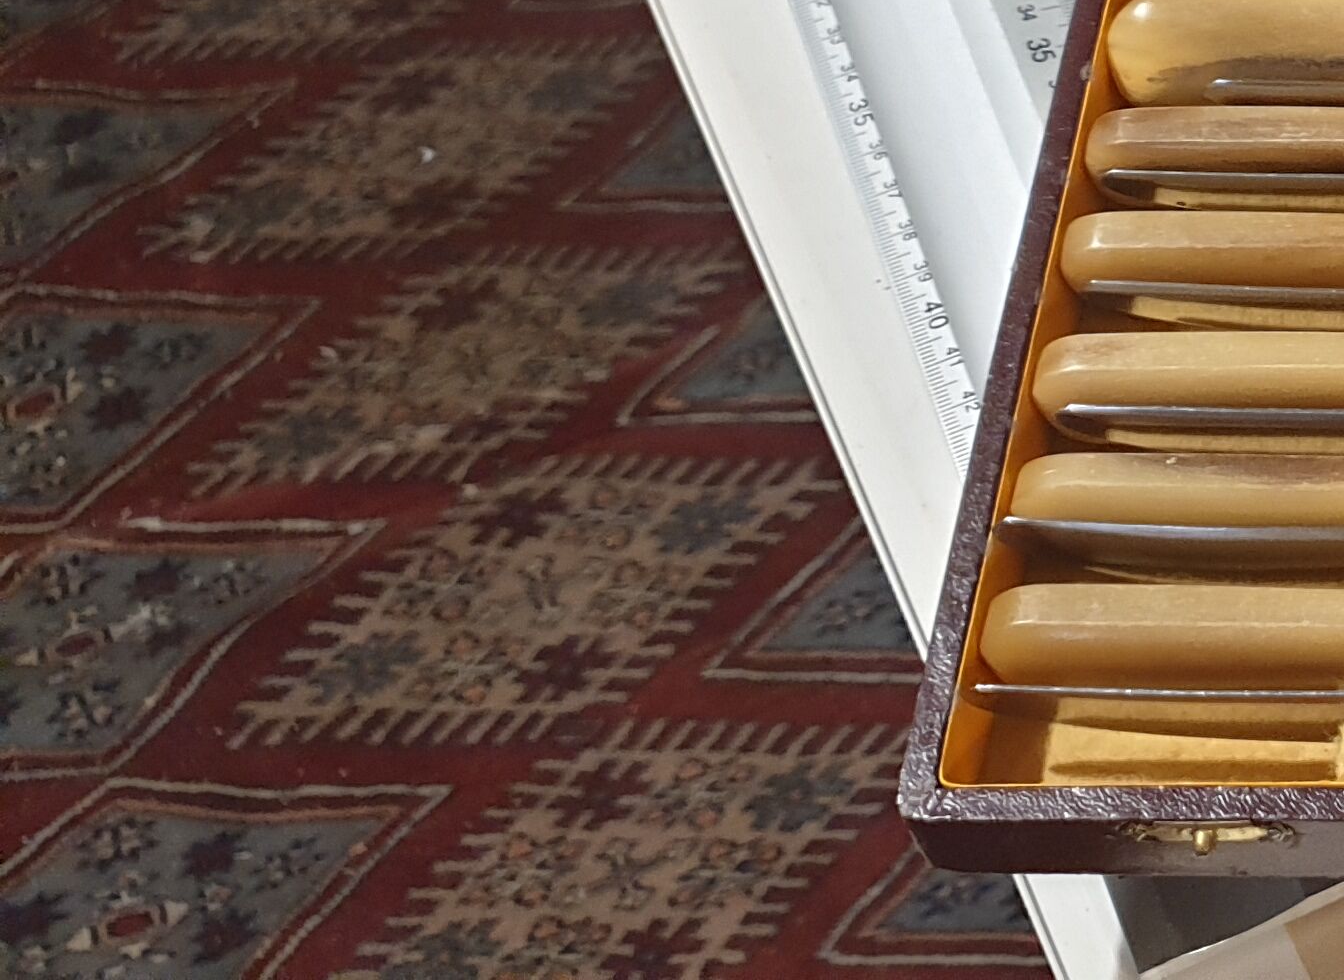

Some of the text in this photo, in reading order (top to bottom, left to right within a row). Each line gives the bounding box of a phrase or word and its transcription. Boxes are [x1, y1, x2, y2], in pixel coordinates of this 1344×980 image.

[1017, 4, 1038, 21] 34
[1027, 38, 1056, 63] 35
[848, 99, 874, 126] 35
[869, 140, 889, 161] 36
[884, 179, 903, 198] 37
[898, 219, 918, 241] 38
[914, 260, 933, 282] 39
[924, 302, 949, 329] 40
[946, 347, 964, 367] 41
[962, 391, 981, 413] 42
